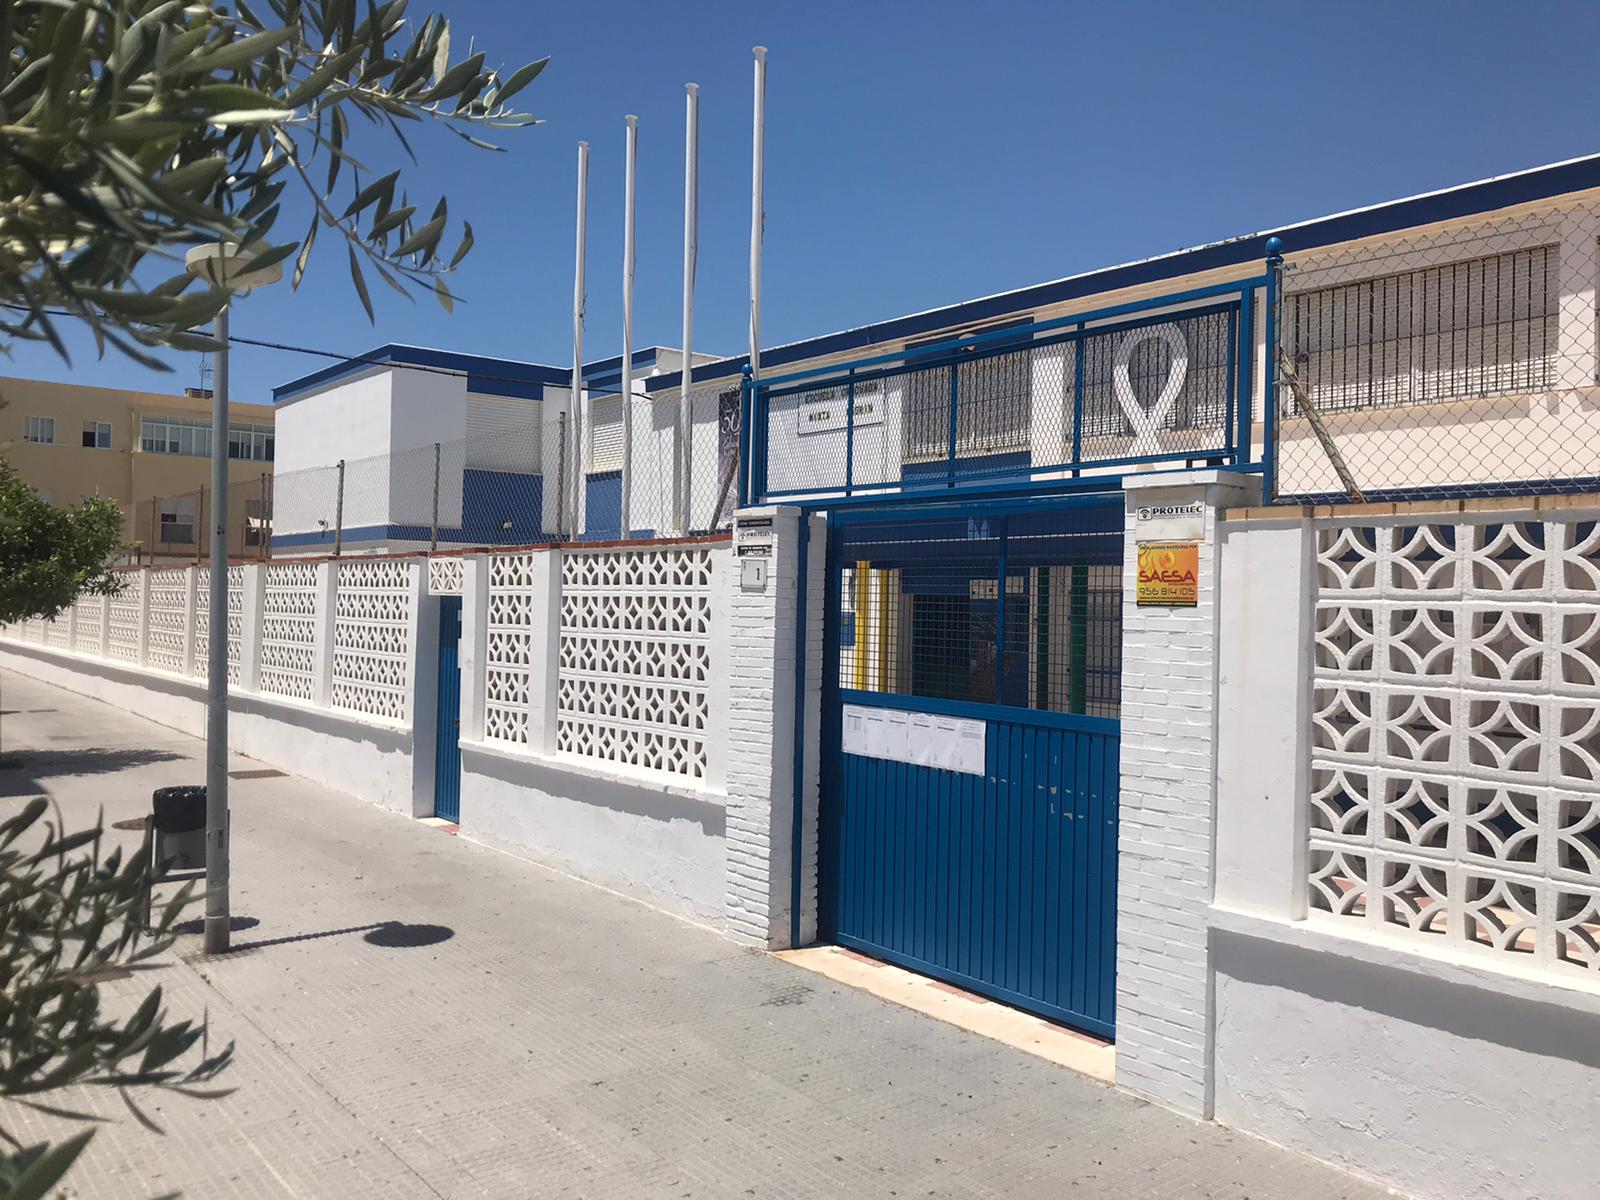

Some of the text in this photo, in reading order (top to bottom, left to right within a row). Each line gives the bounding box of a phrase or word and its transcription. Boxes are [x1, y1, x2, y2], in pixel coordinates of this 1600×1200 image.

[1153, 506, 1202, 514] PROTELEC
[1139, 570, 1196, 582] SAESA
[1139, 588, 1195, 596] 956 814 105
